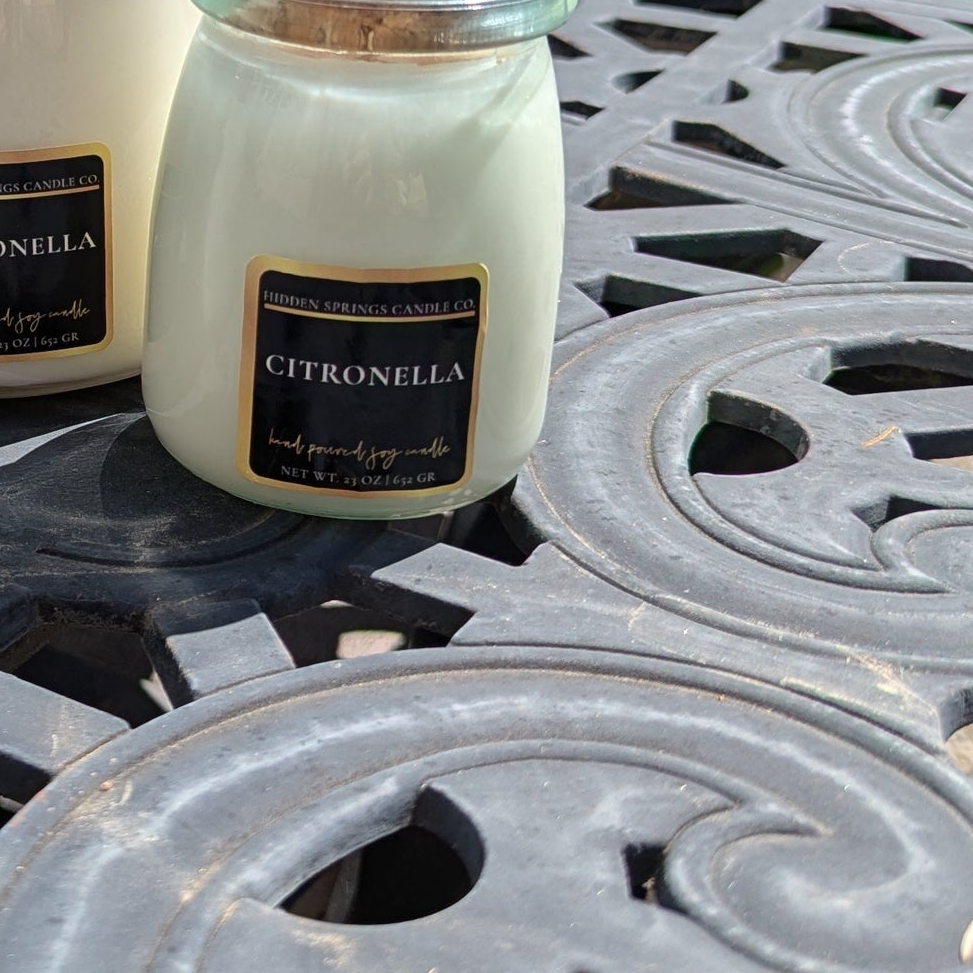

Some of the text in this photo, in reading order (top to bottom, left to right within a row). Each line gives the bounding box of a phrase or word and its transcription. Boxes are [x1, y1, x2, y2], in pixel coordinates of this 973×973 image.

[23, 177, 75, 192] CANDLE
[263, 290, 319, 310] HIDDEN
[323, 300, 387, 315] SPRINGS
[392, 301, 450, 315] CANDLE
[13, 338, 30, 348] OZ
[41, 336, 58, 346] 652
[61, 332, 79, 343] GR
[265, 354, 465, 386] CITRONELLA
[280, 465, 309, 479] NET
[344, 477, 357, 486] 23
[361, 476, 381, 485] OZ
[393, 475, 412, 485] 652
[417, 472, 436, 483] GR
